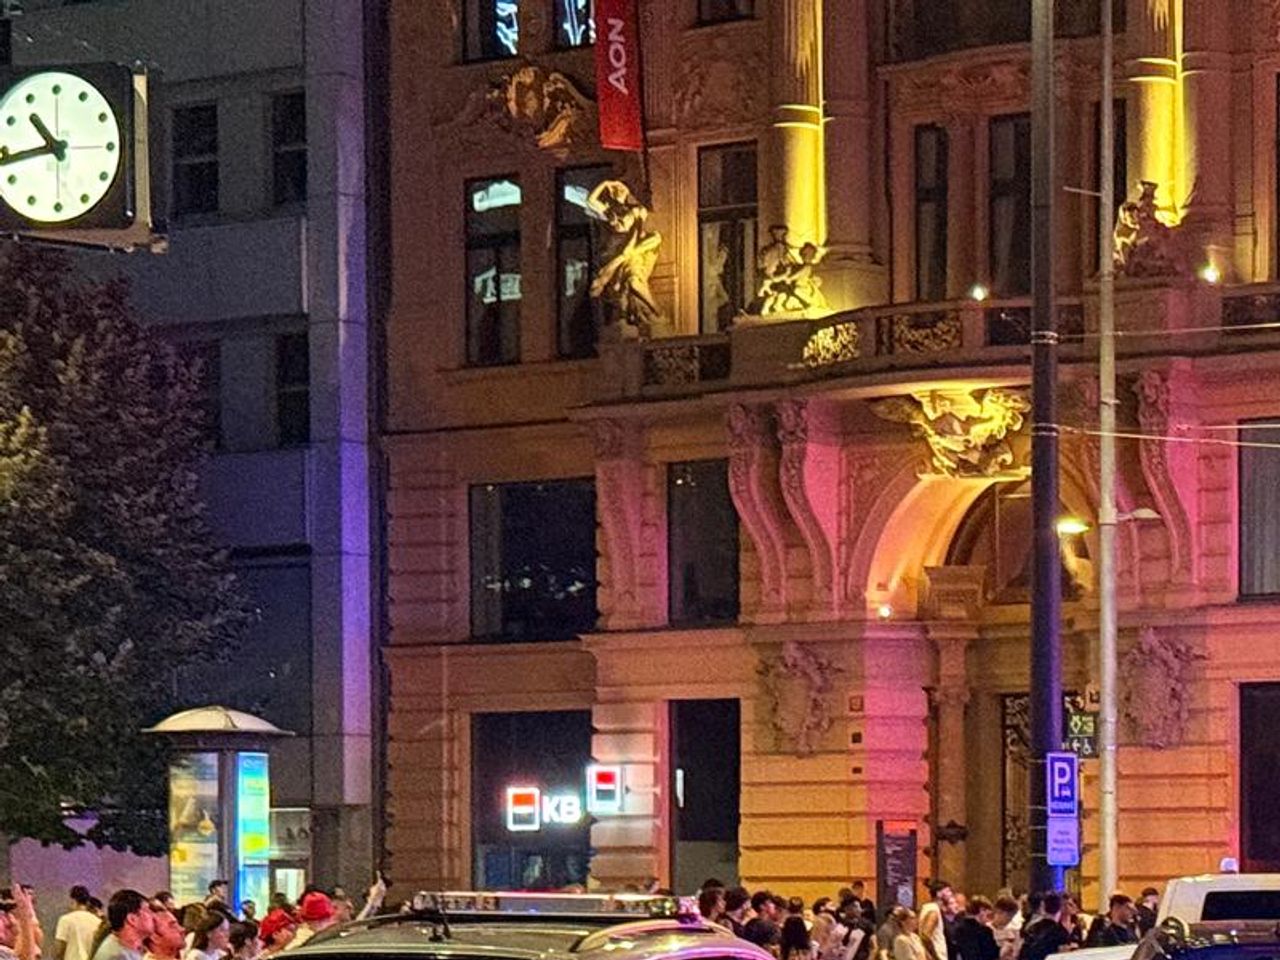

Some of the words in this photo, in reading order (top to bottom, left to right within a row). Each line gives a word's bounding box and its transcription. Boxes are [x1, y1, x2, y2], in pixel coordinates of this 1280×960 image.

[607, 18, 629, 95] AON
[1053, 761, 1072, 797] P
[542, 795, 581, 823] KB
